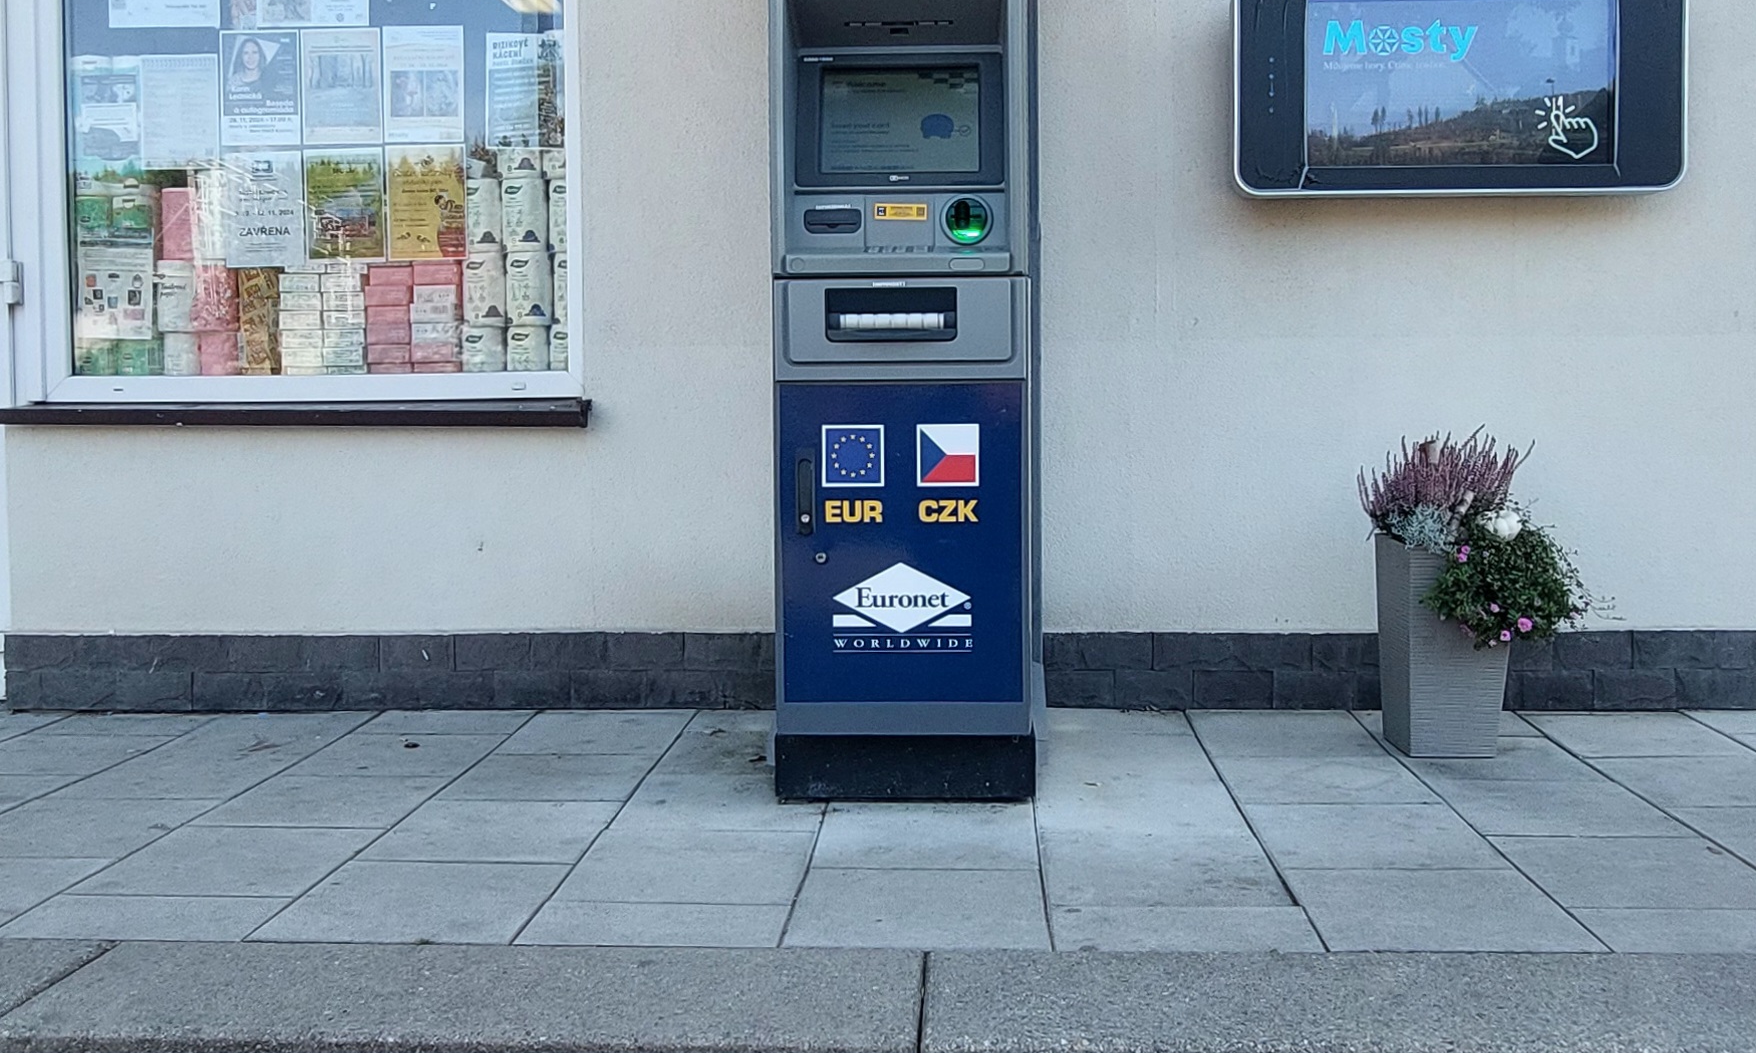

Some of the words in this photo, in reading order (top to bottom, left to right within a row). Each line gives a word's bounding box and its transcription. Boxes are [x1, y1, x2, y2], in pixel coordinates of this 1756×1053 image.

[1322, 19, 1479, 62] Mosty
[238, 225, 291, 238] ZAVŘENA
[824, 500, 883, 523] EUR
[918, 499, 979, 523] CZK
[855, 586, 950, 609] Euronet
[833, 638, 974, 649] WORLDWIDE
